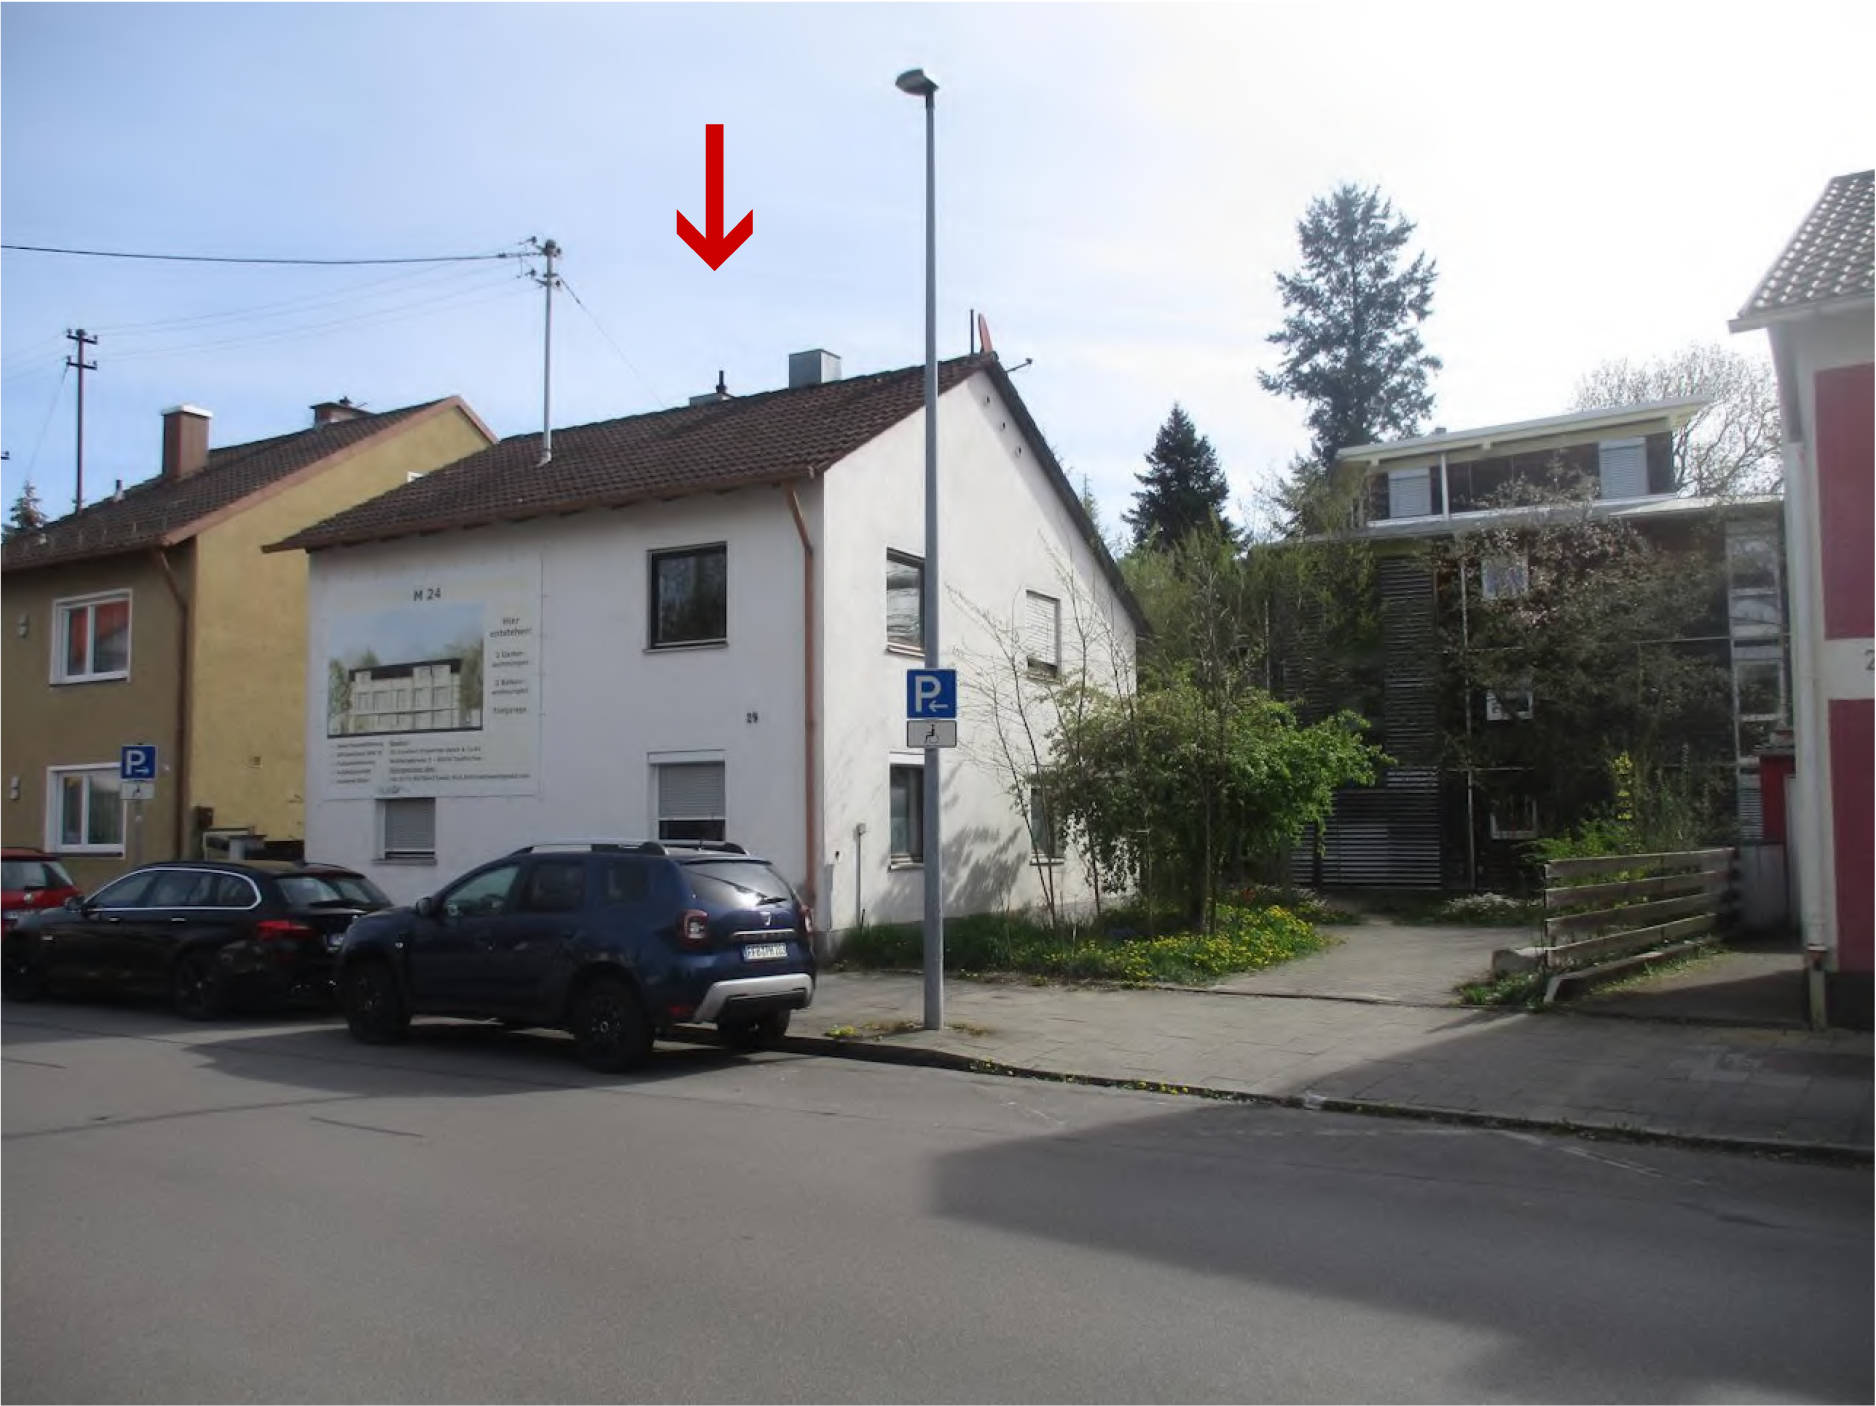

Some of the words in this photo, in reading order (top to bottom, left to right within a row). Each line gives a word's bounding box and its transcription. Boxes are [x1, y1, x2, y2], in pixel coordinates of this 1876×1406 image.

[413, 590, 423, 601] M
[427, 587, 441, 600] 24
[915, 675, 941, 712] P
[126, 750, 146, 775] P
